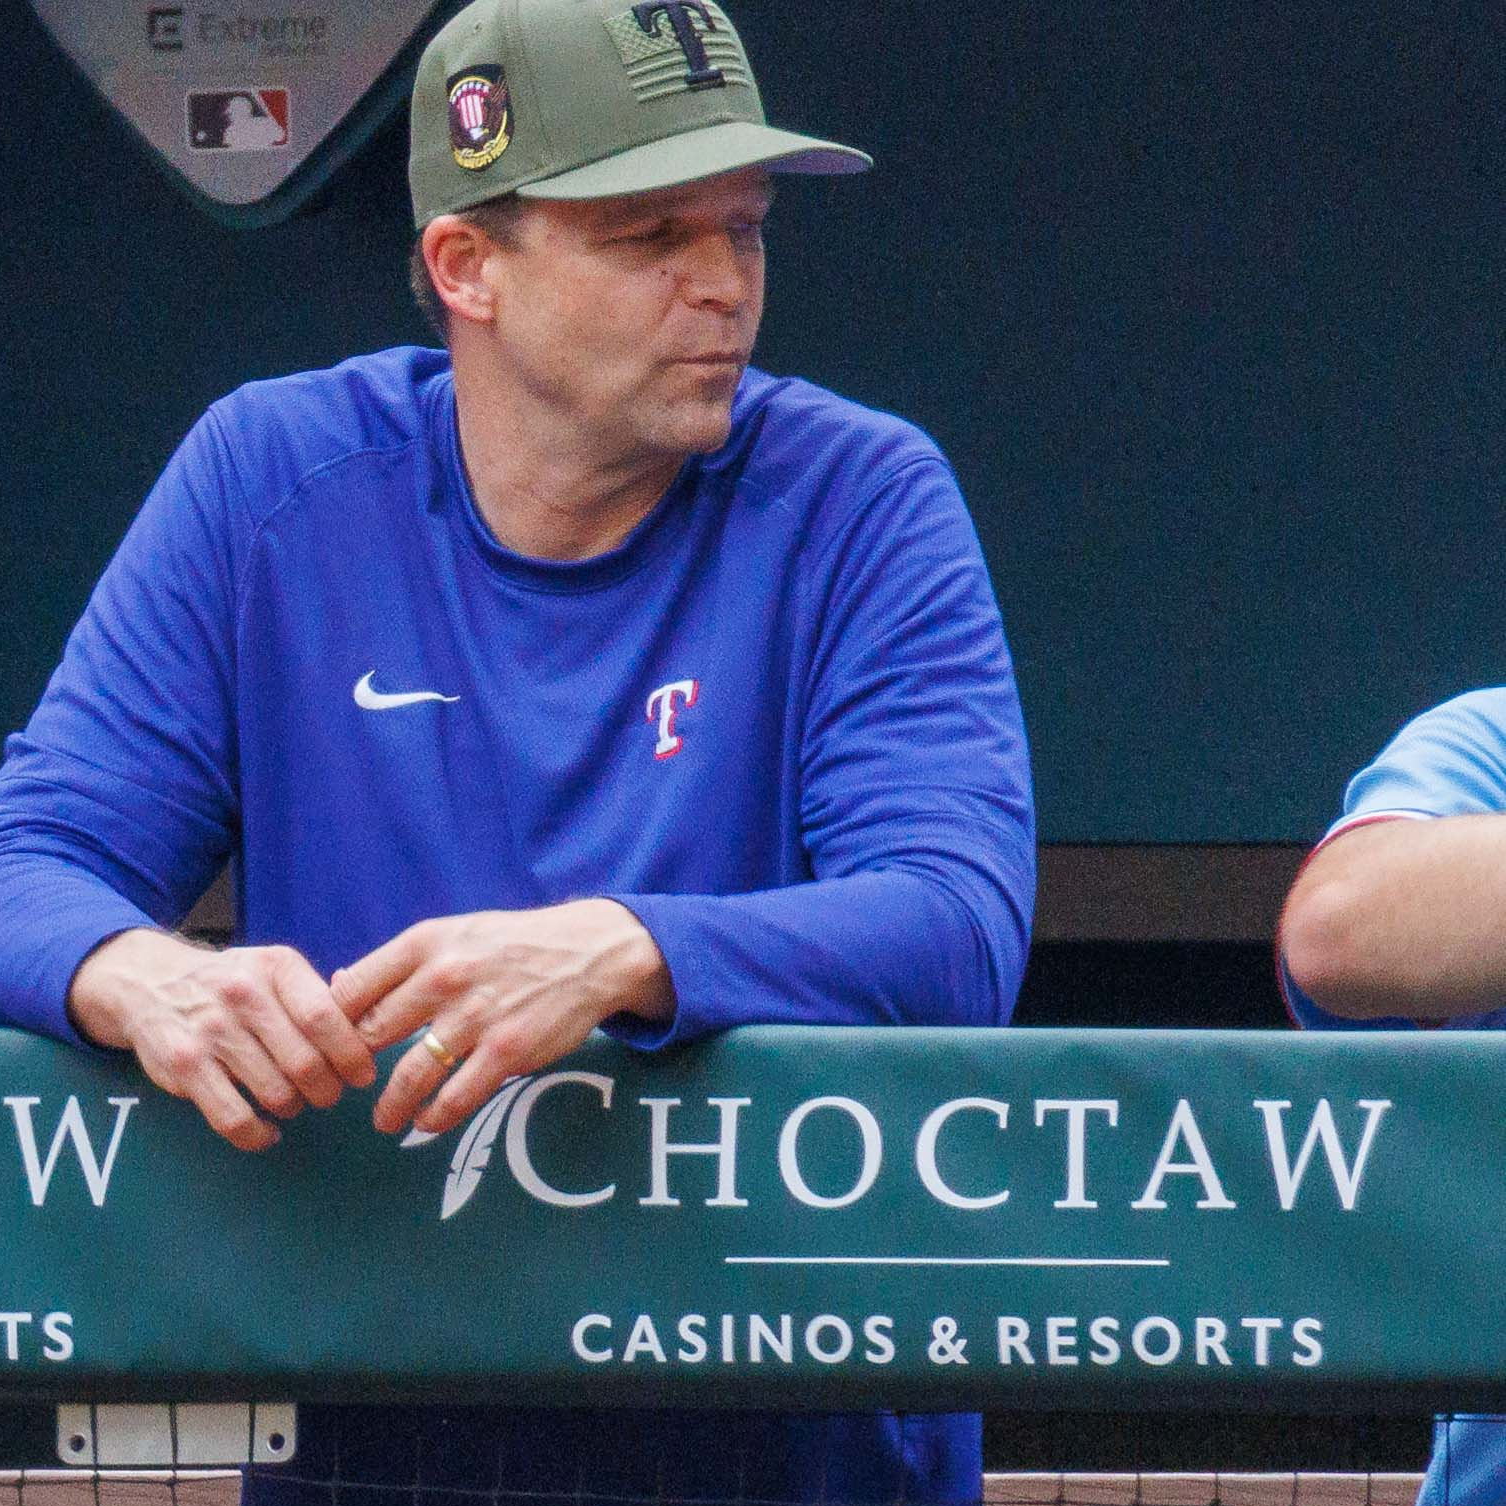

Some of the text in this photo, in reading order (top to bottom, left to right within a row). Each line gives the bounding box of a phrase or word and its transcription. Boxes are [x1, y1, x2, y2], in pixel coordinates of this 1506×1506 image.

[645, 679, 700, 761] T
[505, 1071, 1393, 1211] CHOCTAW
[571, 1313, 1325, 1367] CASINOS & RESORTS
